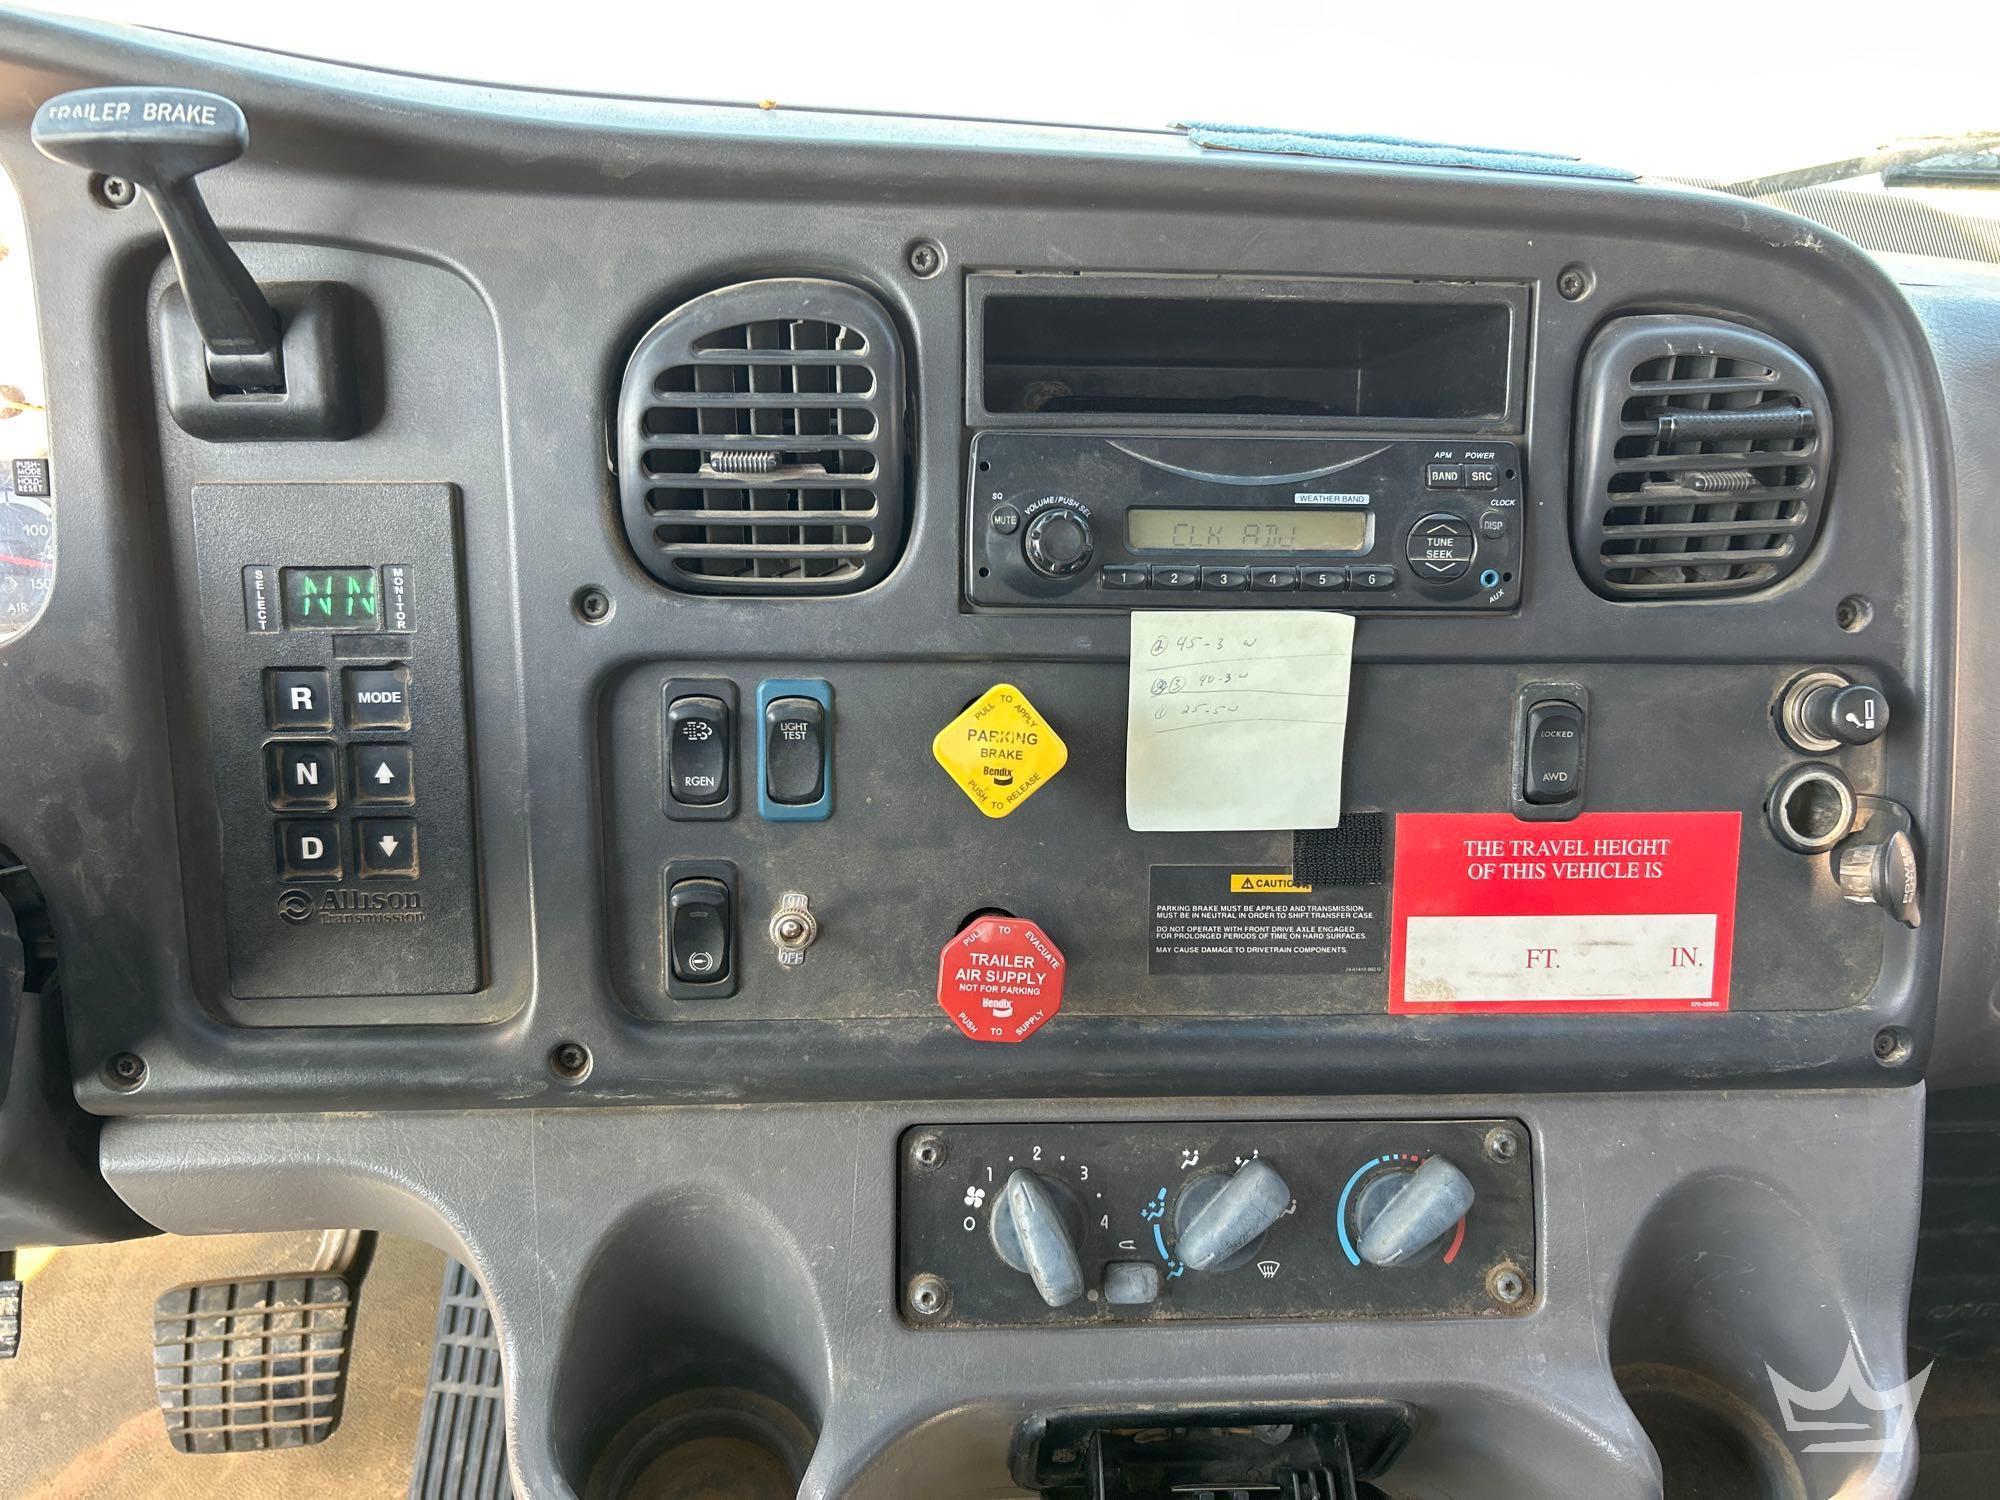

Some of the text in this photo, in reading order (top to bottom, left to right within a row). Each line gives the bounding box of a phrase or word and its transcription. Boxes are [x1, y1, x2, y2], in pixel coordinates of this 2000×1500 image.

[49, 102, 217, 126] TRAILER BRAKE
[1434, 451, 1495, 460] APM POWER
[1432, 471, 1492, 481] BAND SRC
[1299, 494, 1366, 503] WEATHER BAND
[1490, 499, 1516, 507] CLOCK
[1078, 504, 1092, 519] SEL
[994, 515, 1017, 525] MUTE
[1484, 521, 1503, 531] DISP
[24, 524, 48, 536] 100
[1172, 523, 1223, 547] CLK
[1426, 538, 1454, 547] TUNE
[1426, 549, 1453, 559] SEEK
[30, 578, 51, 590] 150
[1120, 573, 1127, 582] 1
[1170, 574, 1178, 584] 2
[1220, 573, 1228, 584] 3
[1269, 574, 1277, 584] 4
[1319, 574, 1326, 584] 5
[1368, 574, 1376, 584] 6
[255, 569, 267, 630] SELECT
[393, 568, 406, 630] MONITOR
[1488, 588, 1505, 603] AUX
[7, 602, 28, 612] AIR
[290, 687, 313, 710] R
[358, 691, 402, 704] MODE
[974, 694, 1038, 727] PULL TO APPLY
[780, 722, 808, 731] LIGHT
[783, 731, 807, 740] TEST
[967, 729, 1038, 745] PARKING
[1541, 730, 1574, 738] LOCKED
[980, 748, 1023, 760] BRAKE
[296, 762, 319, 785] N
[983, 766, 1013, 777] Bendix
[1542, 771, 1568, 782] AWD
[685, 776, 715, 787] RGEN
[968, 772, 1041, 810] PUSH TO RELEASE
[301, 836, 324, 860] D
[1463, 839, 1670, 857] THE TRAVEL HEIGHT
[1467, 861, 1663, 880] OF THIS VEHICLE IS
[1900, 846, 1910, 904] POWER
[320, 889, 422, 910] Allison
[320, 911, 424, 924] Transmission
[998, 925, 1011, 934] TO
[1024, 931, 1061, 969] EVACUATE
[780, 951, 804, 964] OFF
[969, 953, 1035, 969] TRAILER
[1526, 947, 1703, 969] FT. IN.
[955, 968, 1046, 985] AIR SUPPLY
[959, 983, 1041, 996] NOT FOR PARKING
[982, 998, 1013, 1008] Bendix
[957, 1010, 1045, 1036] PUSH TO SUPPLY
[1032, 1145, 1042, 1161] 2
[986, 1166, 993, 1182] 1
[1080, 1165, 1088, 1180] 3
[963, 1216, 976, 1231] 0
[1100, 1214, 1109, 1229] 4
